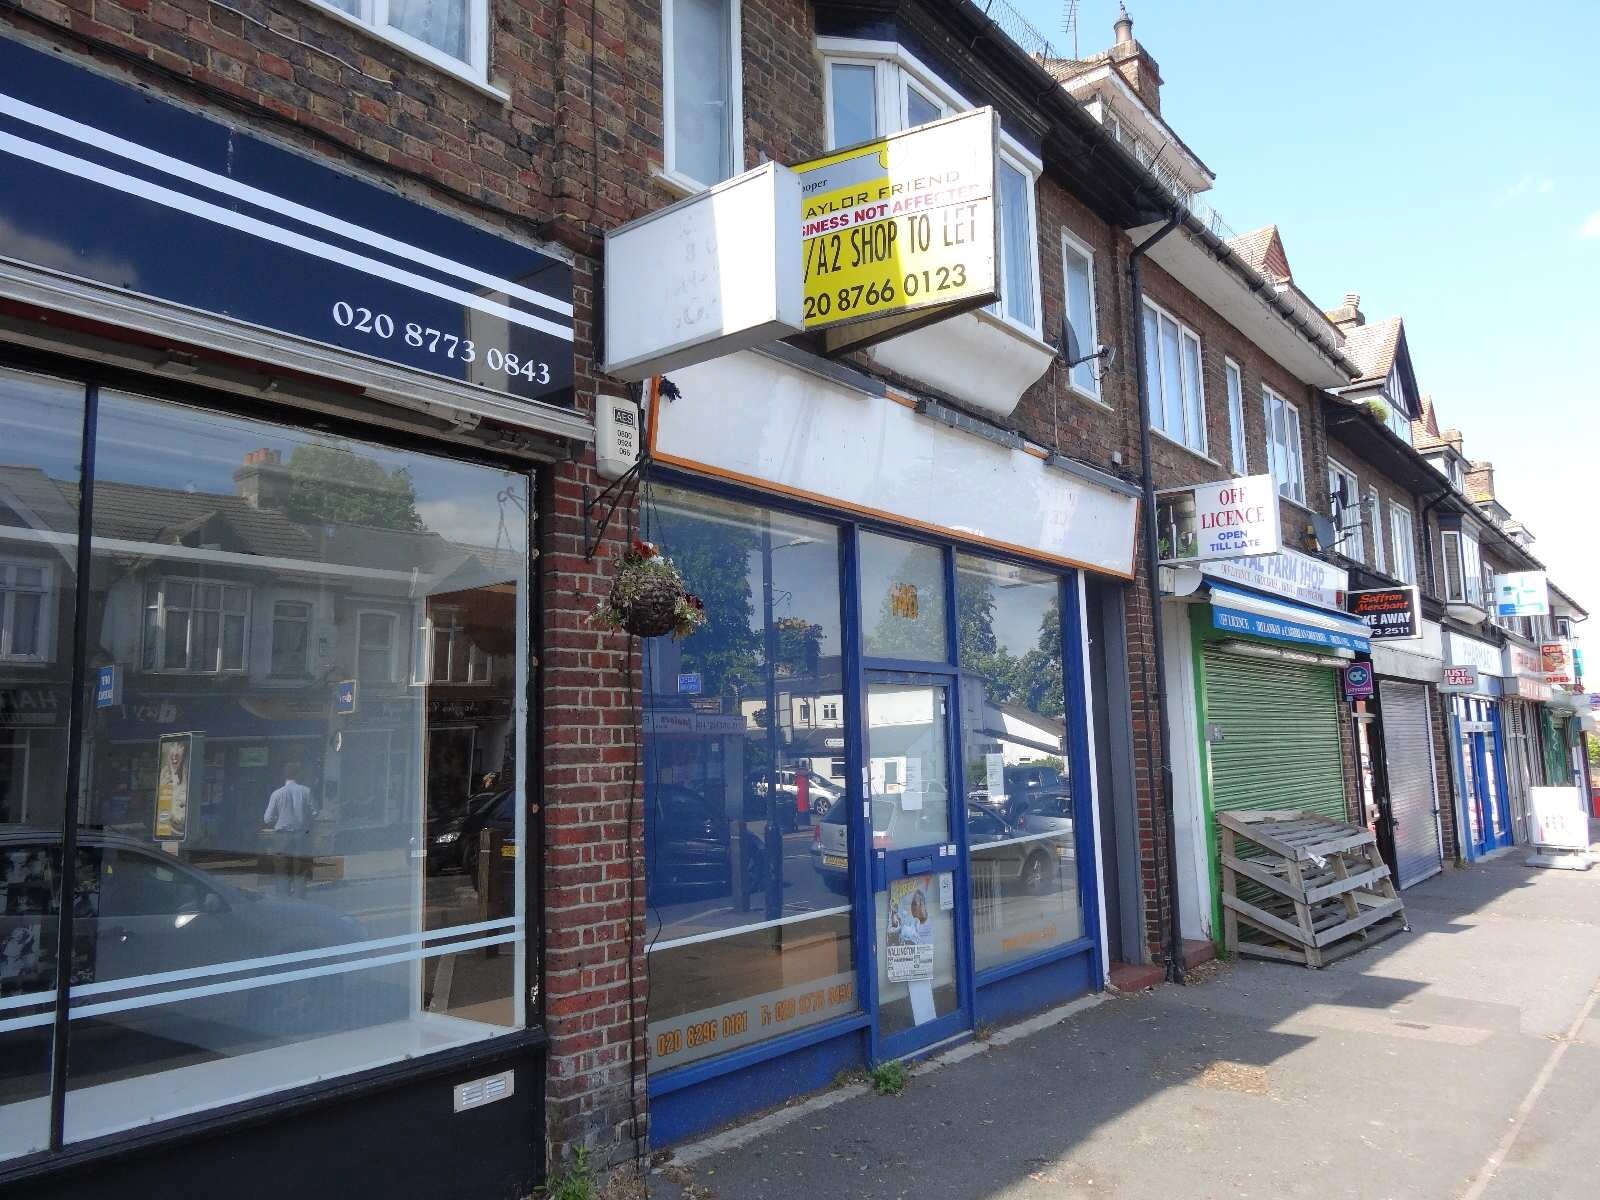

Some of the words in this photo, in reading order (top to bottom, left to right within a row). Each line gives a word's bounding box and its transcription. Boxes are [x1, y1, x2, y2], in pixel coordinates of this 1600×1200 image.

[805, 192, 869, 220] AYLOR
[878, 171, 960, 199] FRIEND
[854, 203, 889, 223] NOT
[803, 235, 842, 284] /A2
[850, 220, 898, 268] SHOP
[907, 213, 931, 254] TO
[943, 203, 978, 247] LET
[803, 292, 831, 319] 20
[838, 278, 895, 312] 8766
[903, 263, 967, 297] 0123
[332, 301, 394, 339] 020
[404, 322, 476, 363] 8773
[487, 348, 551, 385] 0843
[1219, 487, 1246, 505] OFF
[1201, 506, 1265, 529] LICENCE
[1218, 529, 1248, 541] OPEN
[1210, 541, 1232, 551] TILL
[1234, 539, 1260, 549] LATE
[1360, 593, 1402, 603] Saffron
[1356, 601, 1409, 612] Merchant
[1360, 614, 1378, 626] KE
[1380, 612, 1411, 625] AWAY
[1385, 626, 1410, 635] 2511
[1444, 668, 1467, 677] JUST
[1449, 676, 1466, 685] EAT
[656, 1028, 683, 1058] 020
[686, 1019, 718, 1049] 8296
[722, 1010, 748, 1040] 0181
